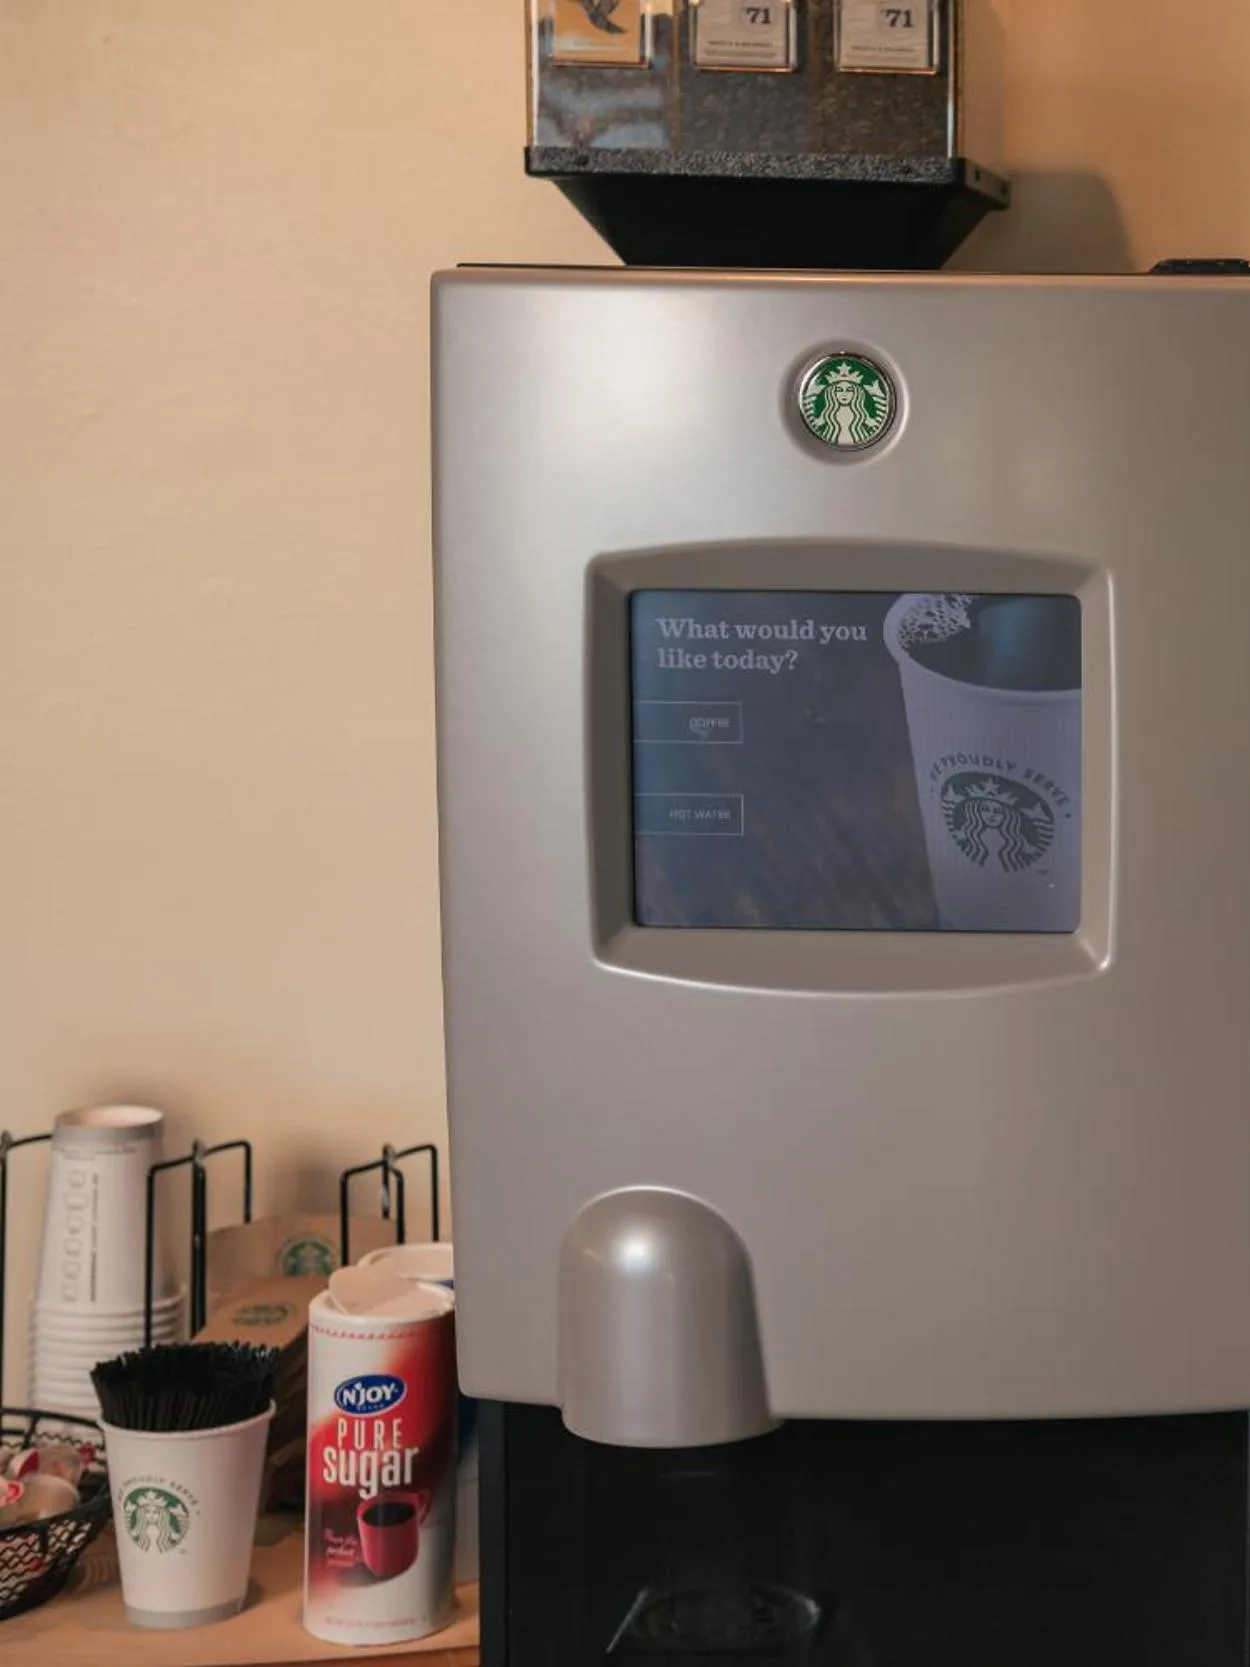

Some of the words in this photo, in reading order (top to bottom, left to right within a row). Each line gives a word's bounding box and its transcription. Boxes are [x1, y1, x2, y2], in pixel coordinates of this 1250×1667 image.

[746, 7, 771, 25] 71
[886, 9, 914, 28] 71
[655, 618, 729, 640] What
[734, 619, 816, 641] would
[819, 623, 868, 645] you
[657, 648, 707, 669] like
[712, 649, 800, 675] today?
[940, 752, 1017, 772] PROUDLY
[337, 1417, 403, 1451] PURE
[322, 1446, 420, 1501] sugar
